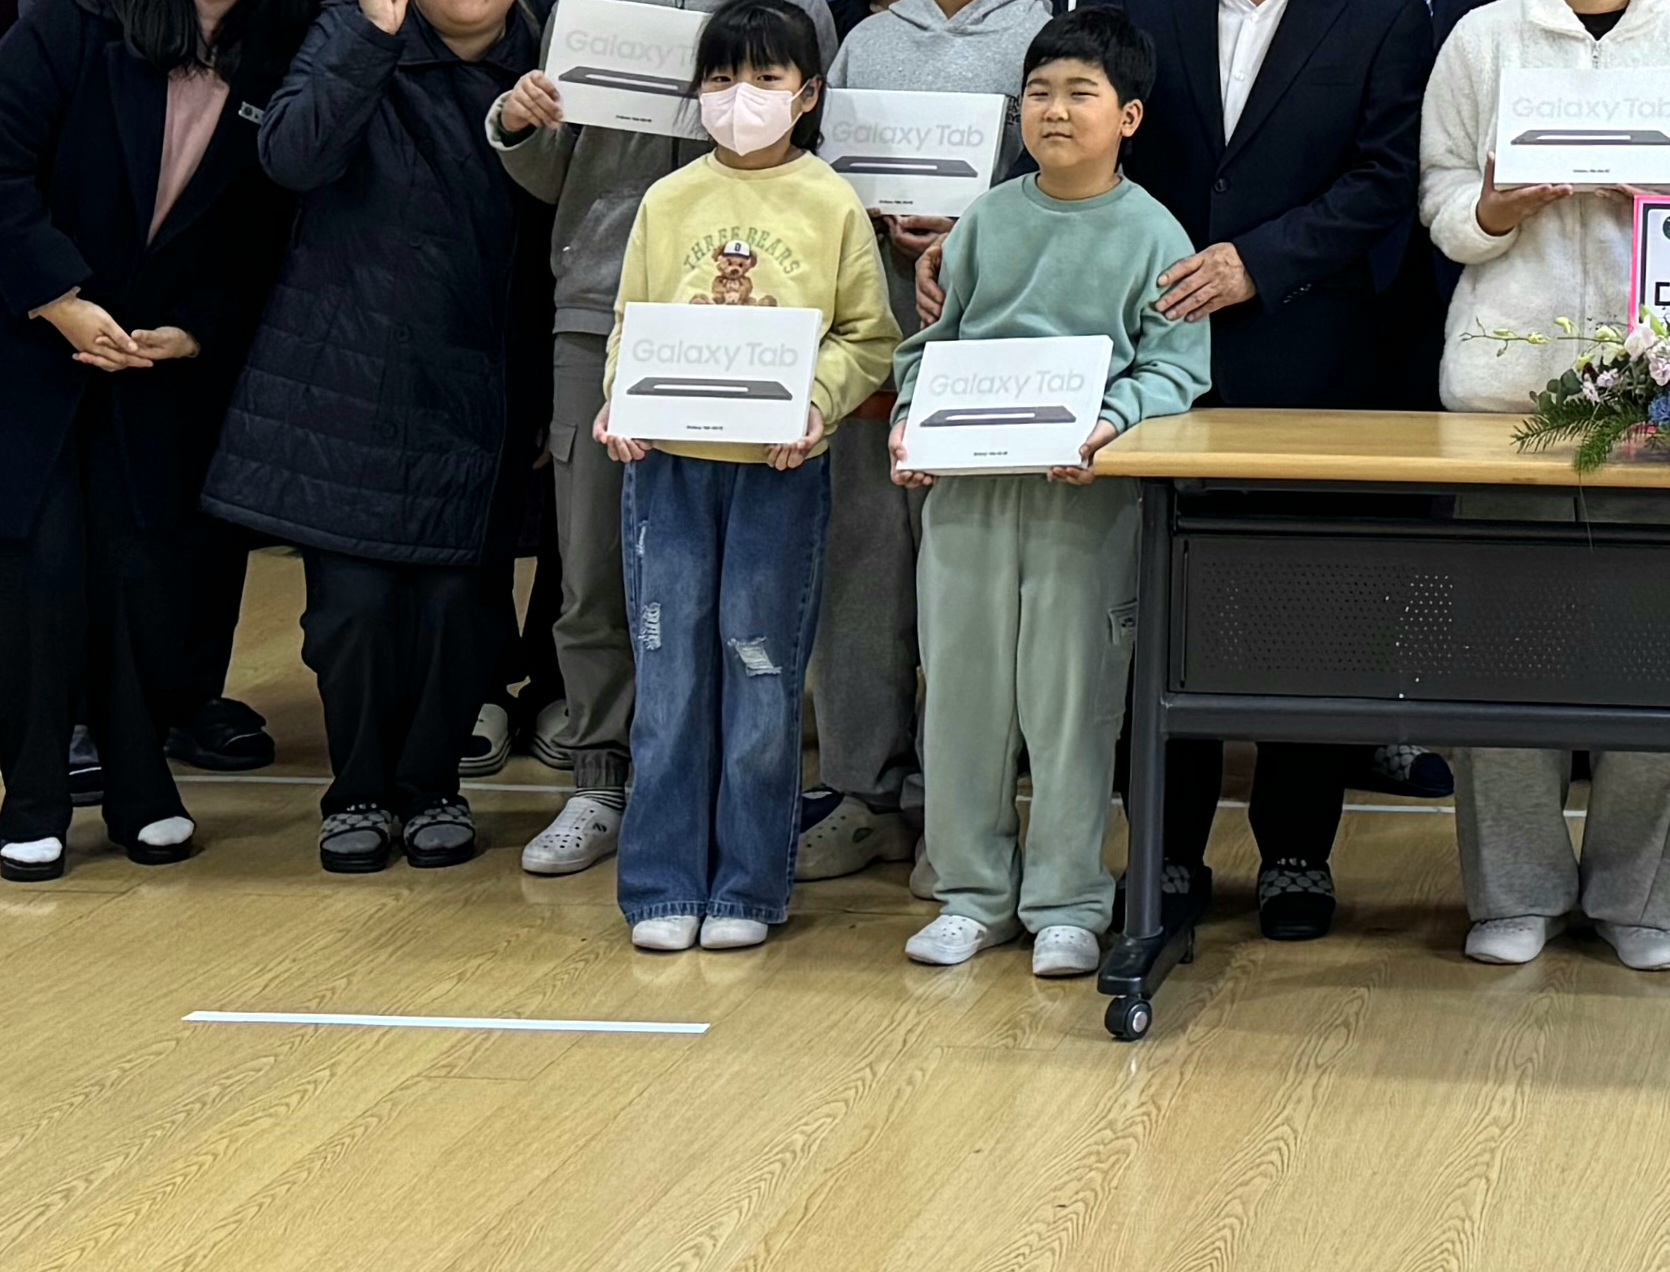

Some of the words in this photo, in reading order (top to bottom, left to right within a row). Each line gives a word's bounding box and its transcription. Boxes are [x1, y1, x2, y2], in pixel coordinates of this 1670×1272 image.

[566, 29, 672, 68] Galaxy
[1512, 97, 1620, 122] Galaxy
[832, 121, 931, 151] Galaxy
[936, 124, 985, 147] Tab
[684, 226, 741, 270] THREE
[747, 227, 801, 274] BEARS
[632, 339, 741, 372] Galaxy
[746, 342, 799, 367] Tab
[928, 373, 1032, 399] Galaxy
[1035, 368, 1086, 393] Tab
